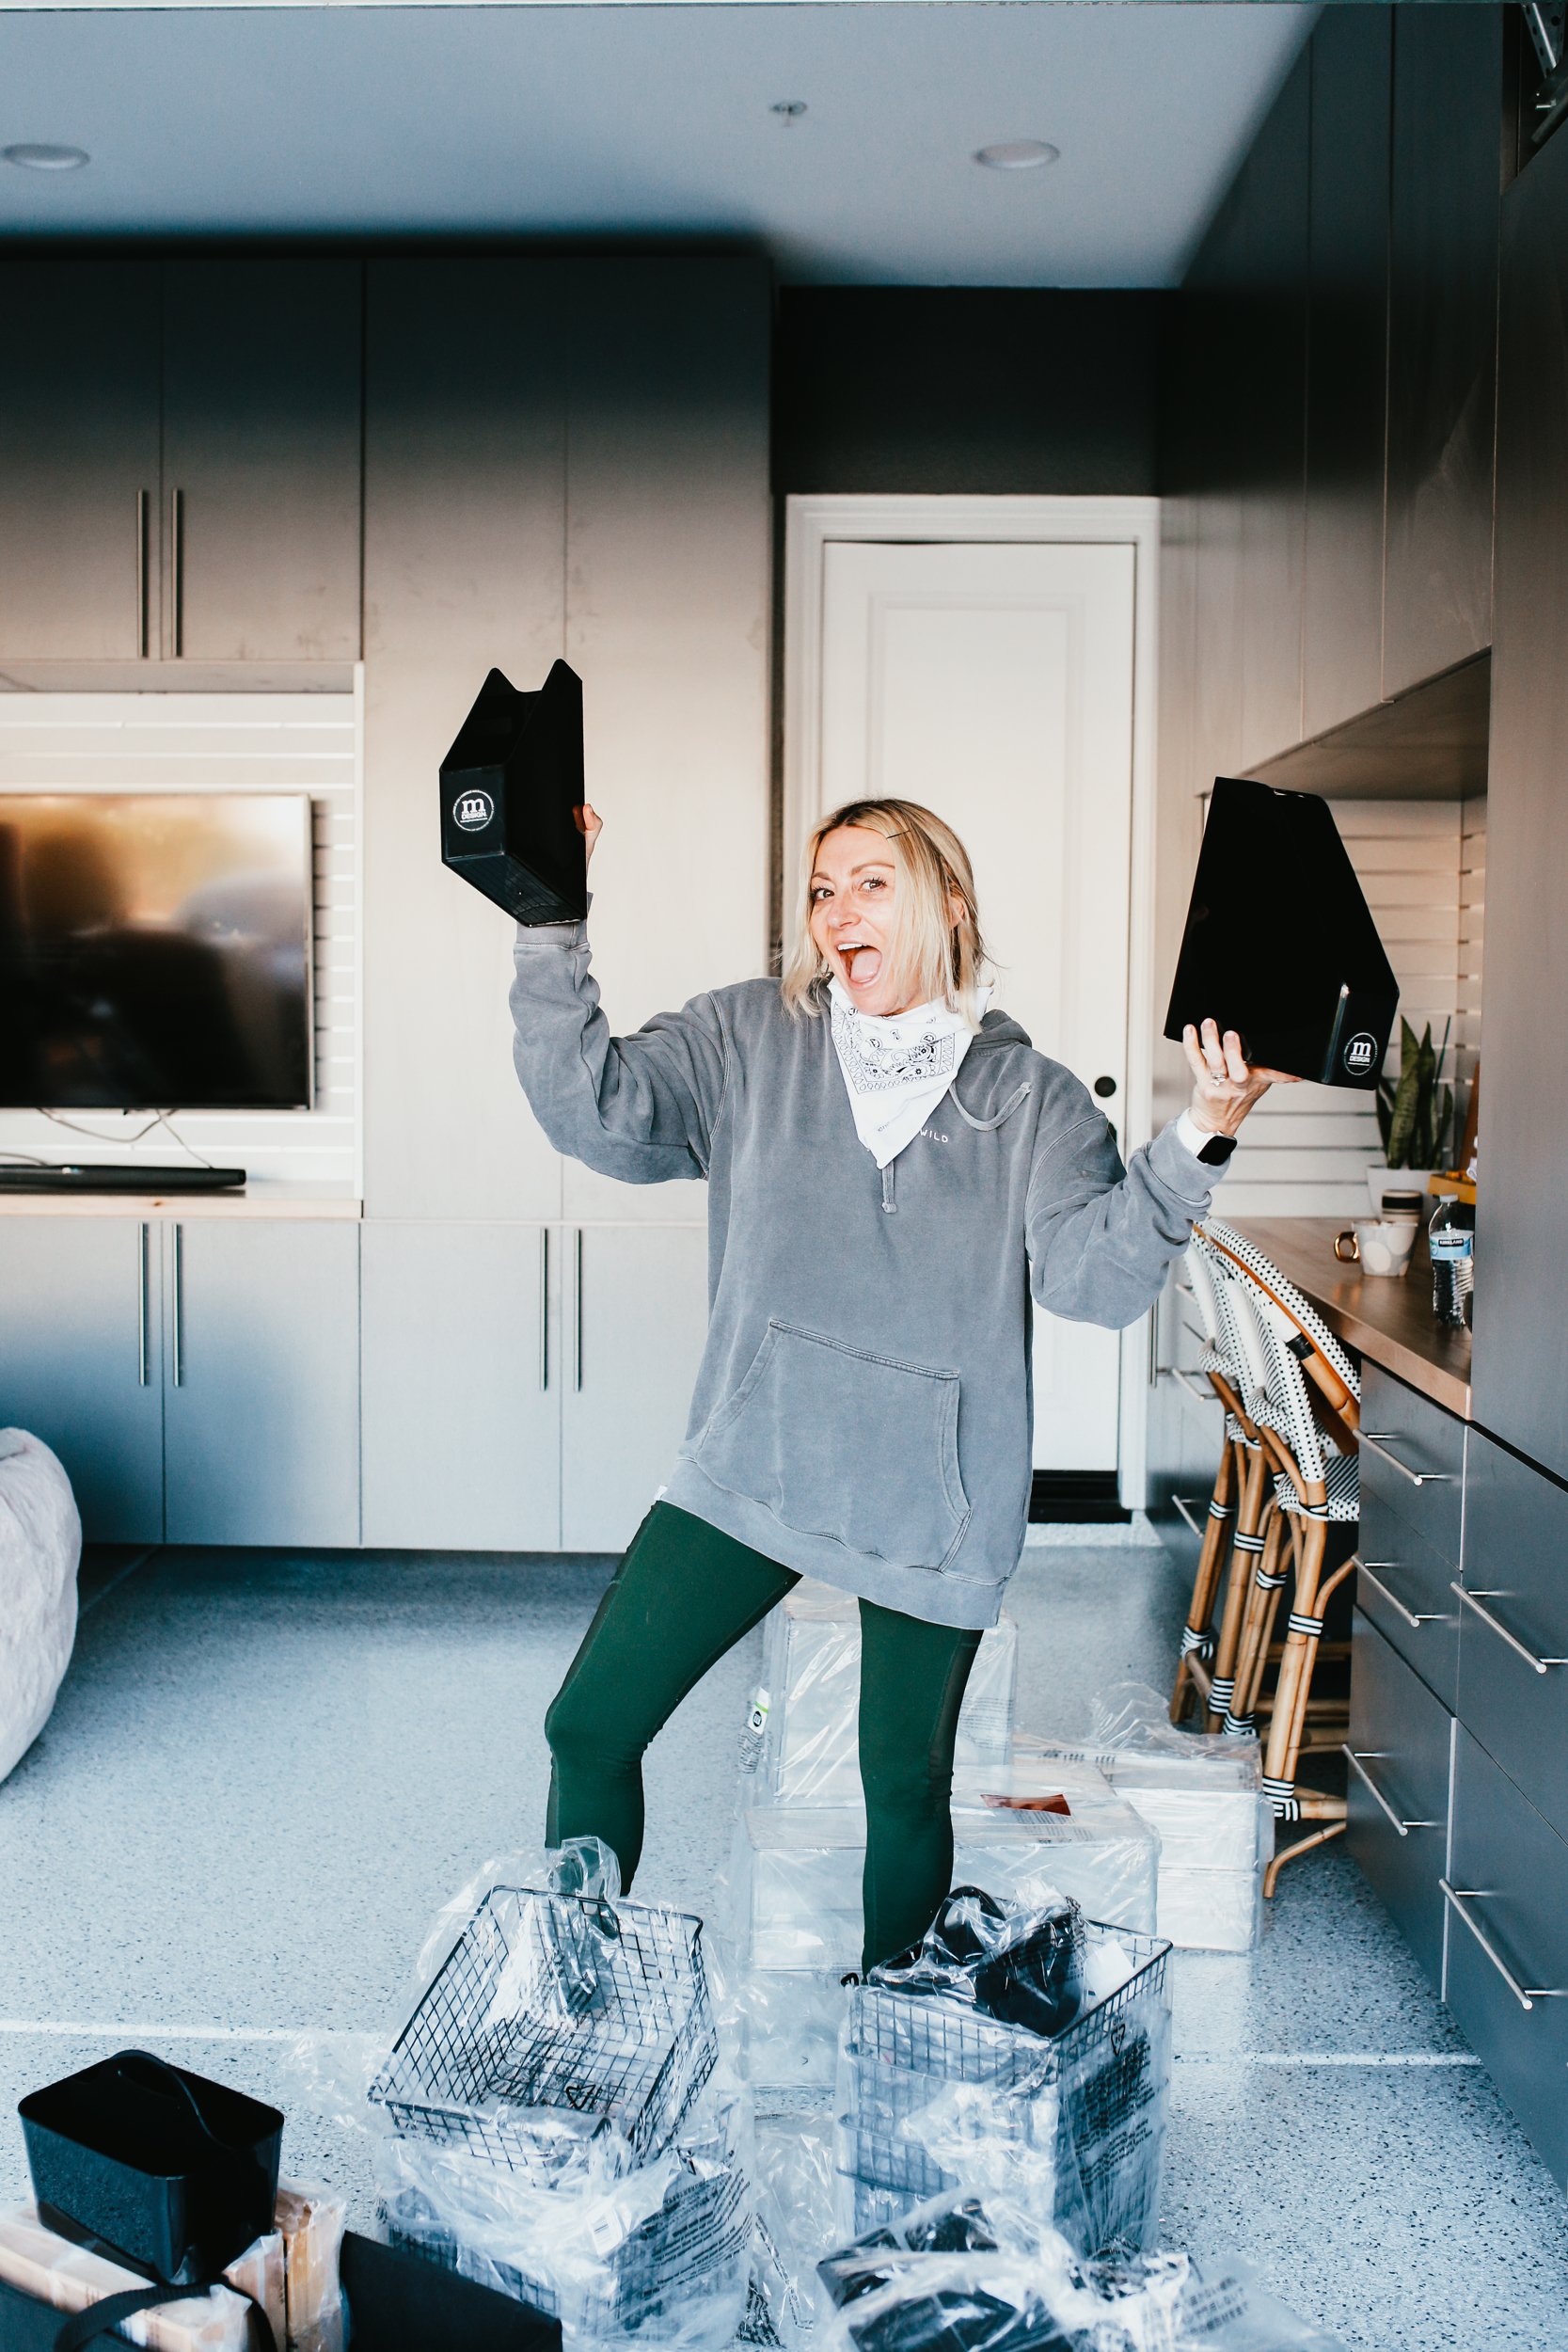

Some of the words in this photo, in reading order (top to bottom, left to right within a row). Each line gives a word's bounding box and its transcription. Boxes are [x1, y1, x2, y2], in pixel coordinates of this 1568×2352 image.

[462, 798, 486, 813] m
[1351, 1041, 1371, 1056] m
[920, 1129, 948, 1142] WILD
